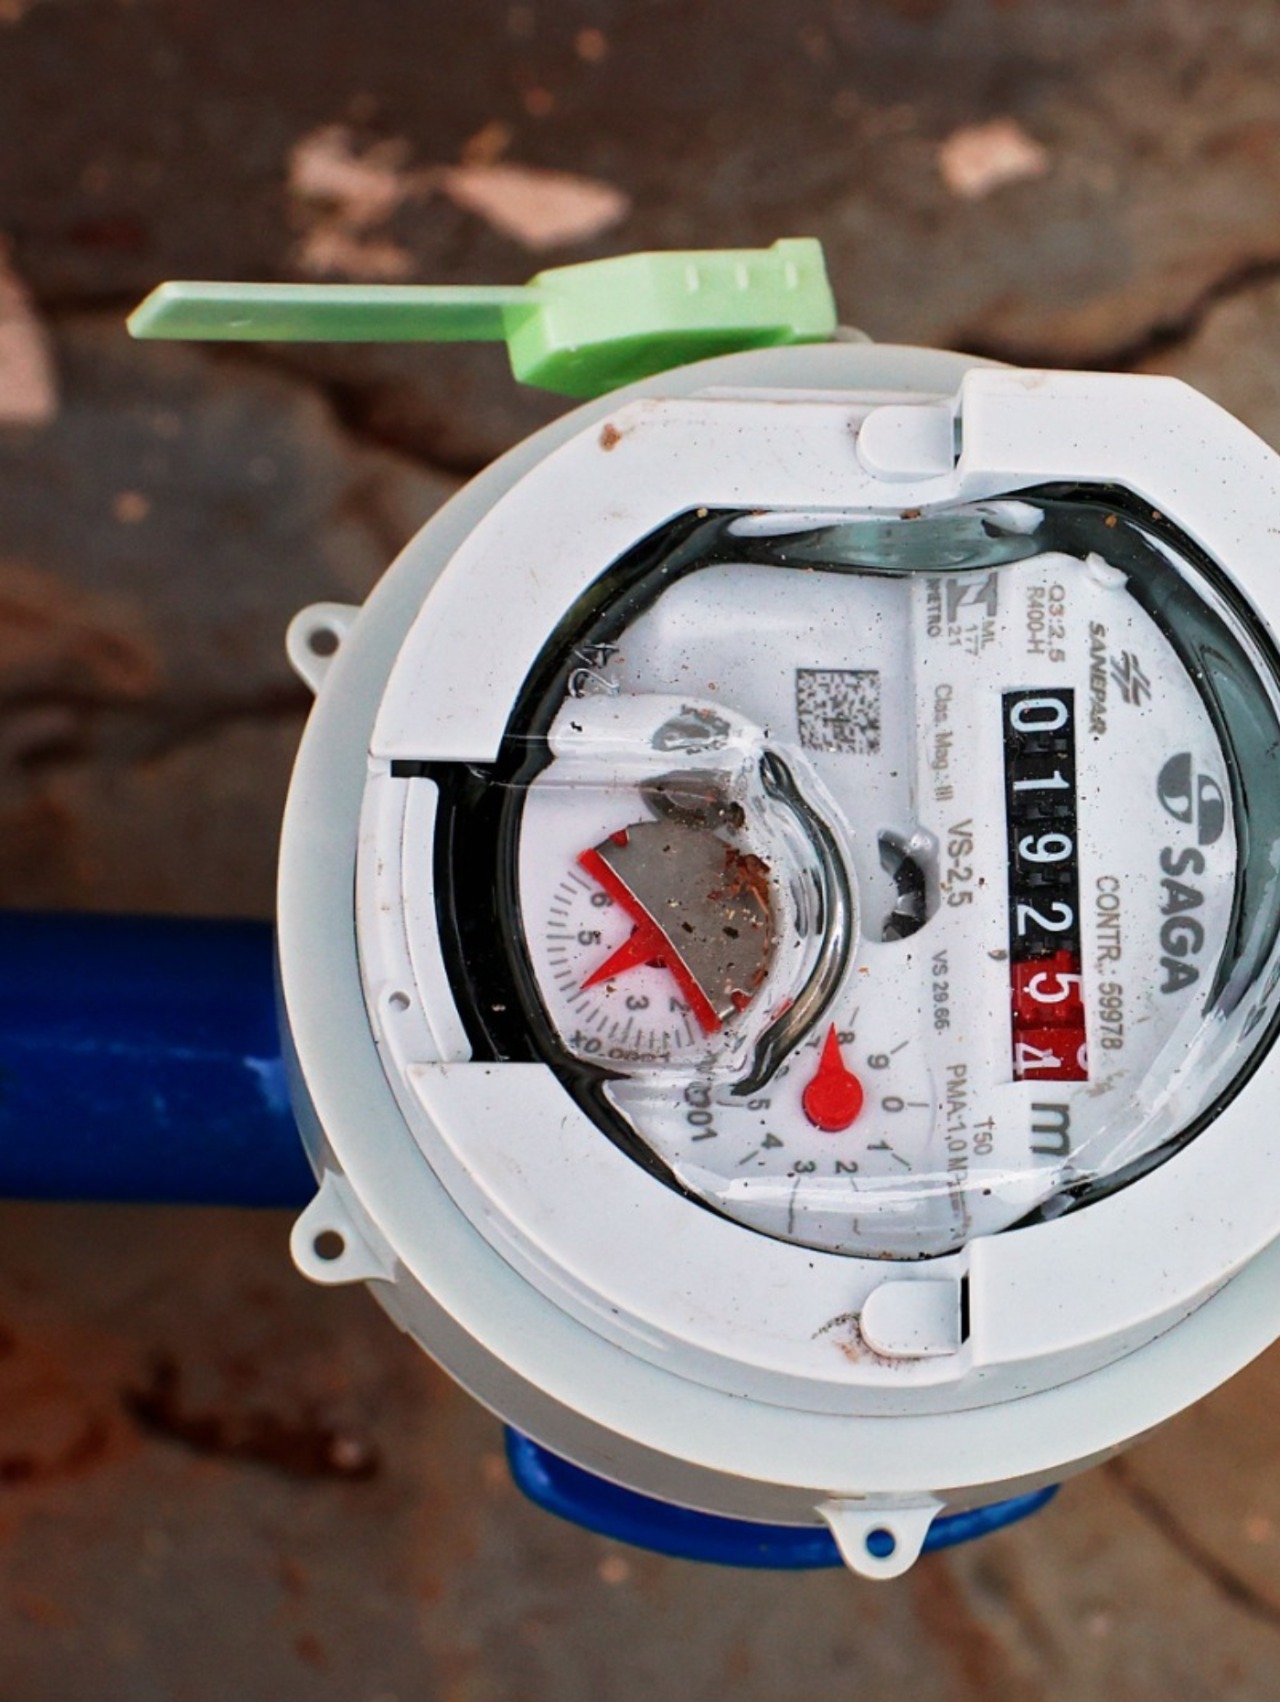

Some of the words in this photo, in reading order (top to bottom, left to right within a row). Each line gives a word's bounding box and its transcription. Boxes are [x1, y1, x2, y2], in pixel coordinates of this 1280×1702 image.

[1027, 586, 1046, 655] R400-H
[1088, 620, 1107, 735] SANEPAR
[941, 818, 974, 908] VS-2,5
[1159, 846, 1205, 995] SAGA
[577, 930, 602, 946] 5
[931, 949, 948, 977] VS
[625, 995, 649, 1012] 3
[1099, 982, 1123, 1051] 59978
[837, 1030, 856, 1045] 8
[867, 1054, 890, 1070] 9
[747, 1098, 771, 1111] 5
[881, 1096, 905, 1113] 0
[760, 1132, 784, 1151] 4
[972, 1115, 995, 1156] T50
[866, 1139, 892, 1152] 1
[794, 1160, 817, 1175] 3
[835, 1160, 859, 1175] 2
